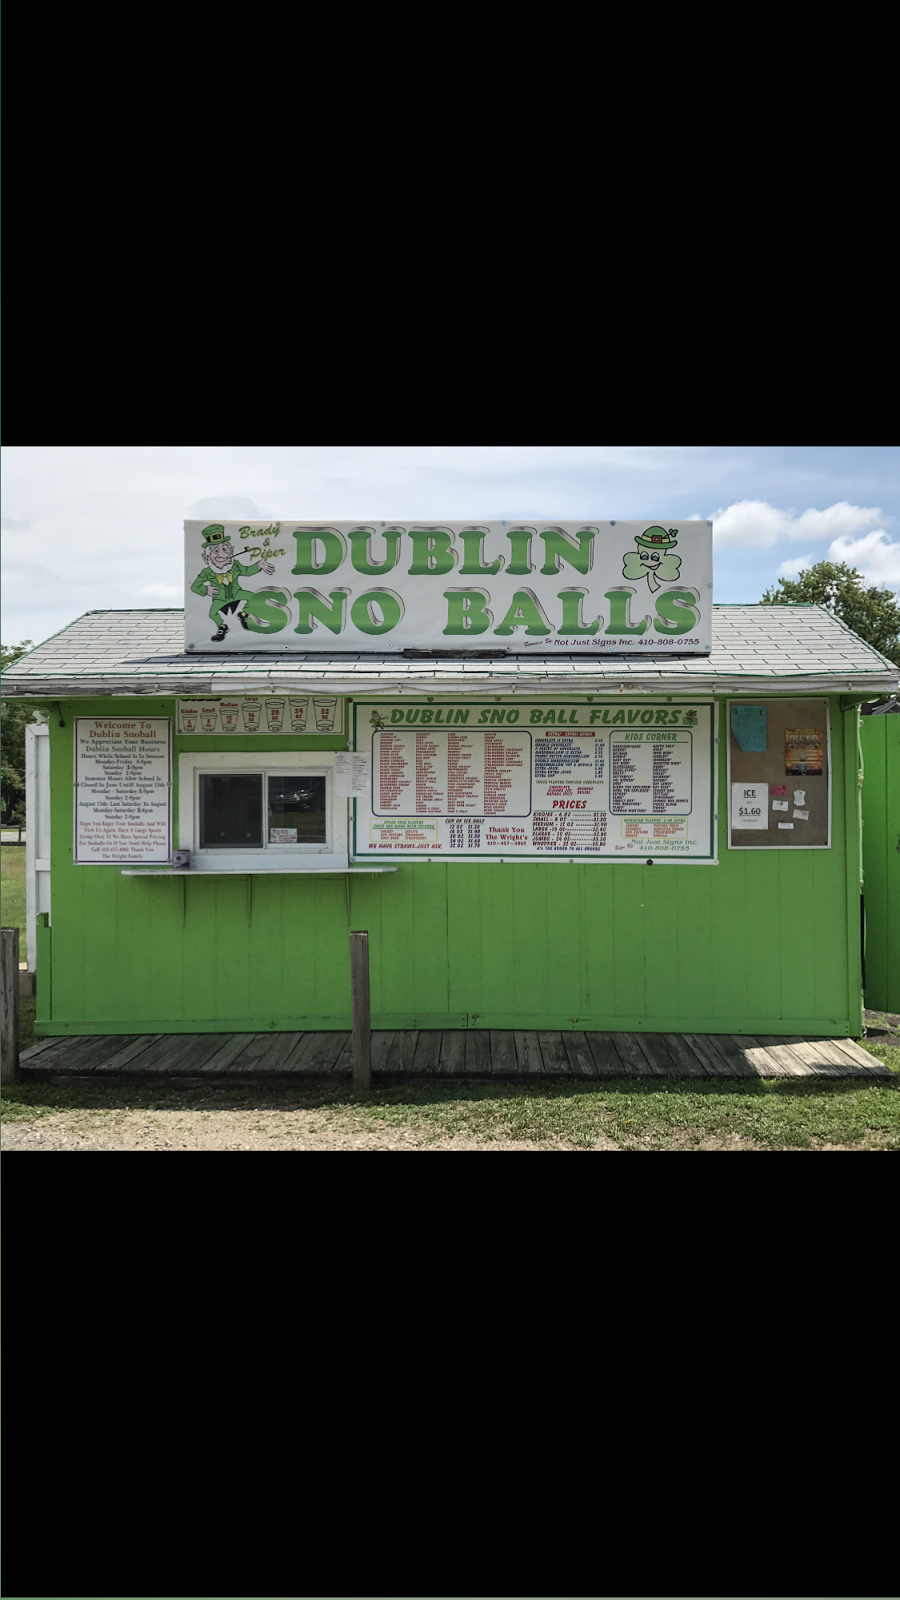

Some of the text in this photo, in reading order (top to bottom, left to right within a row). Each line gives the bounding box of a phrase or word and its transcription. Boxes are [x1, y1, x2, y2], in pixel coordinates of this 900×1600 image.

[238, 523, 281, 539] Brady
[249, 546, 286, 561] Piper
[290, 526, 599, 576] DUBLIN
[249, 587, 701, 635] SNO BALLS
[592, 639, 616, 647] Signs
[390, 709, 682, 725] DUBLIN SNO BALL FLAVORS
[553, 800, 587, 809] PRICES
[739, 807, 761, 815] $1.60
